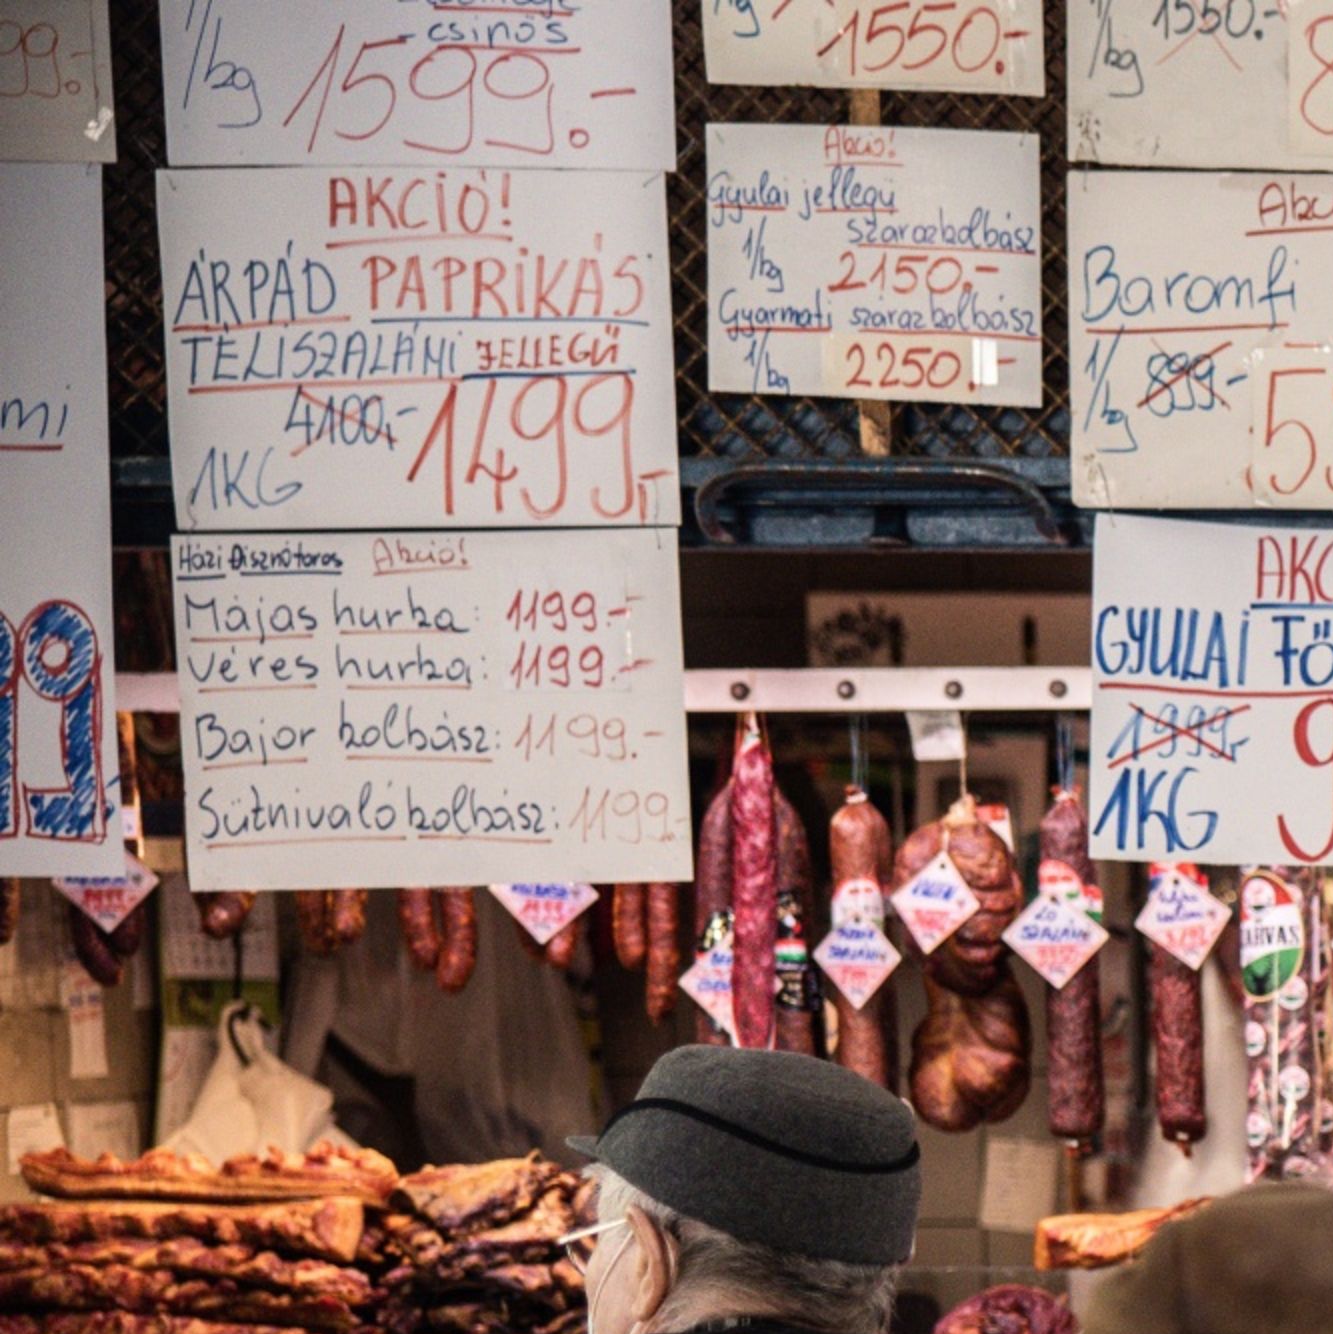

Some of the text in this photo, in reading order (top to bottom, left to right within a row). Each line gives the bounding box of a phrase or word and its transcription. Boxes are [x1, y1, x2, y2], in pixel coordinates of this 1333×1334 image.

[816, 2, 1031, 76] 1550.-
[328, 172, 513, 232] AKCIÓ!
[174, 234, 647, 325] ÁRPÁD PAPRIKÁS
[190, 449, 303, 512] 1KG
[1097, 606, 1251, 688] GYULAI
[195, 712, 316, 764] Bajor
[1092, 766, 1219, 854] 1KG
